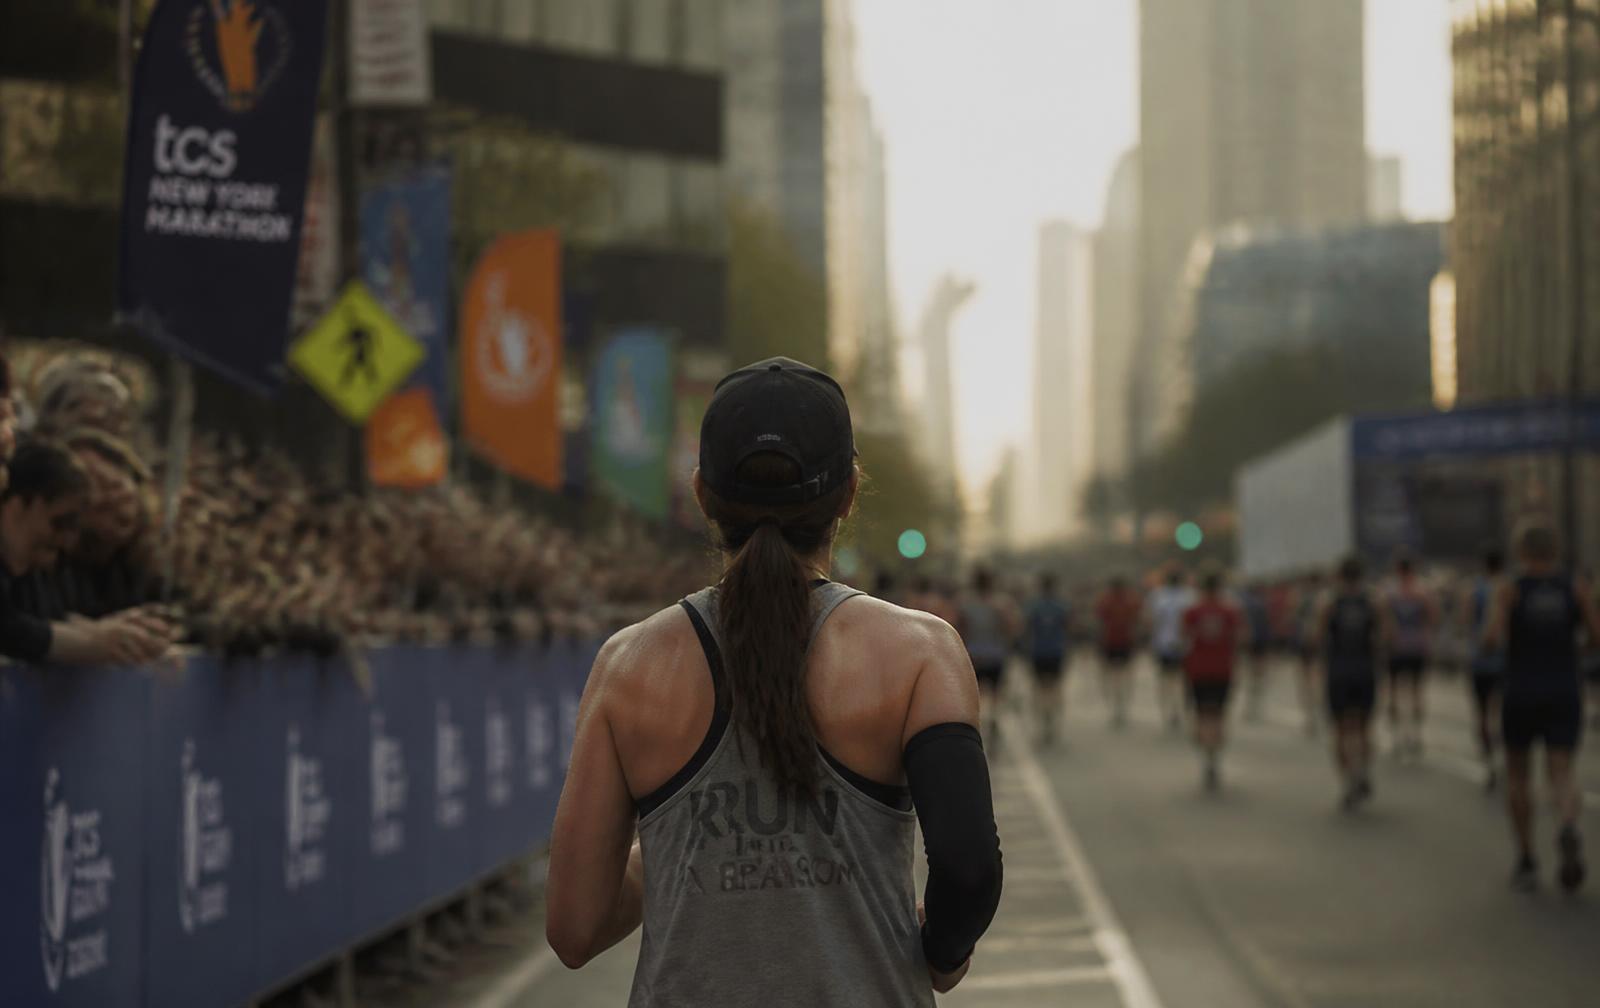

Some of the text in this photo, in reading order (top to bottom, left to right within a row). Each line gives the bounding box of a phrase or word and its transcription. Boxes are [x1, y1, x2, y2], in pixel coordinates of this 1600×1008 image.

[154, 114, 238, 178] tcs
[149, 177, 279, 210] NEW YORK
[146, 205, 293, 242] MARATHON
